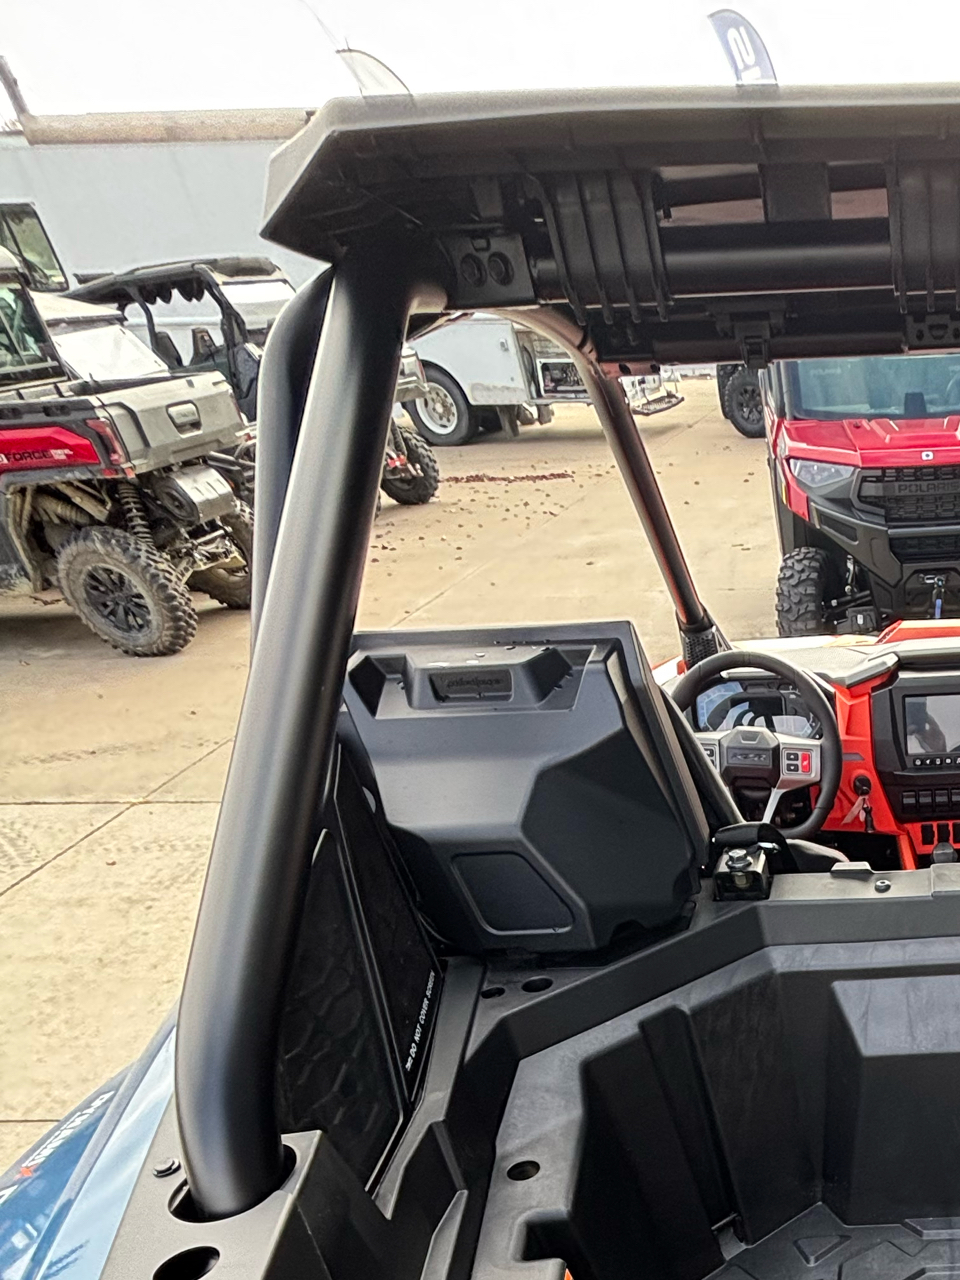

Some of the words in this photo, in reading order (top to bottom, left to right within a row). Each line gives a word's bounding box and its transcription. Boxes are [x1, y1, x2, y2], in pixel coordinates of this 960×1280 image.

[897, 480, 960, 494] POLARIS
[409, 1042, 418, 1058] DO
[414, 1023, 422, 1043] NOT
[419, 997, 429, 1025] COVER
[426, 969, 435, 998] SCREEN
